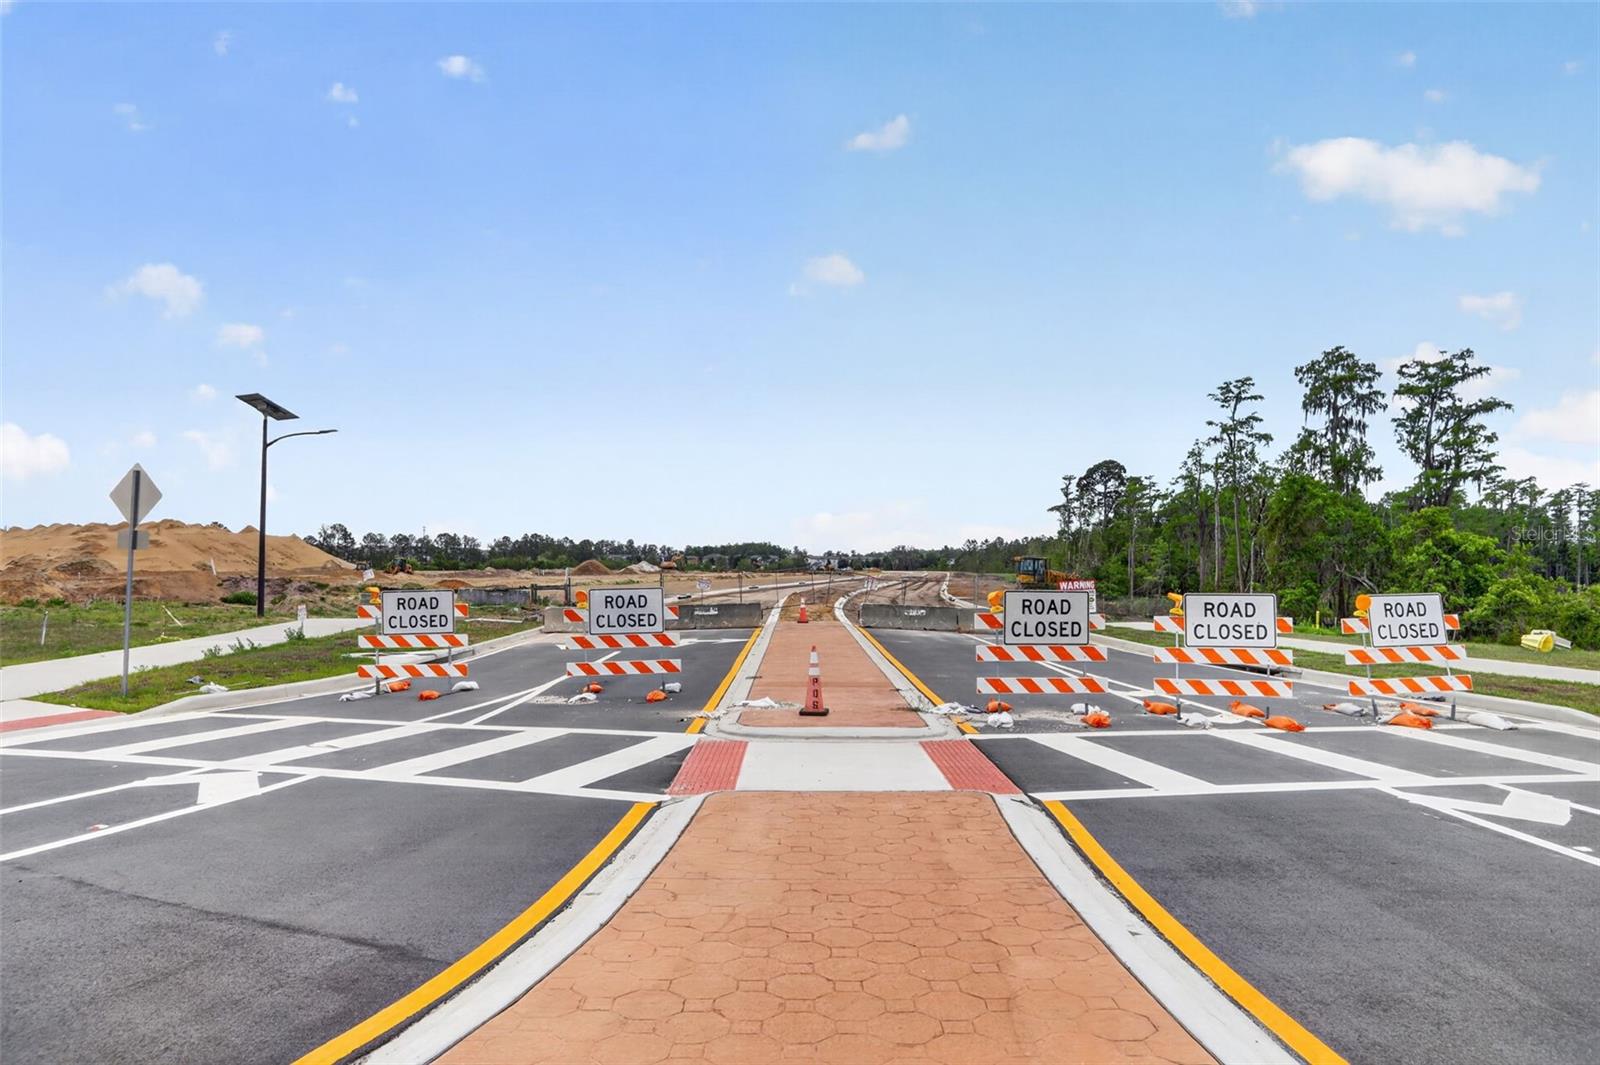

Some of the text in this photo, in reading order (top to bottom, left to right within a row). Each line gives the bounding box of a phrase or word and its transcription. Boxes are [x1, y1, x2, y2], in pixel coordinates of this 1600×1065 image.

[1059, 580, 1095, 590] WARNING
[396, 596, 440, 611] ROAD
[604, 594, 648, 610] ROAD
[1021, 598, 1072, 616] ROAD
[1203, 601, 1256, 618] ROAD
[1383, 601, 1427, 618] ROAD
[388, 614, 449, 629] CLOSED
[595, 612, 658, 629] CLOSED
[1010, 620, 1082, 638] CLOSED
[1193, 623, 1268, 640] CLOSED
[1377, 622, 1439, 640] CLOSED
